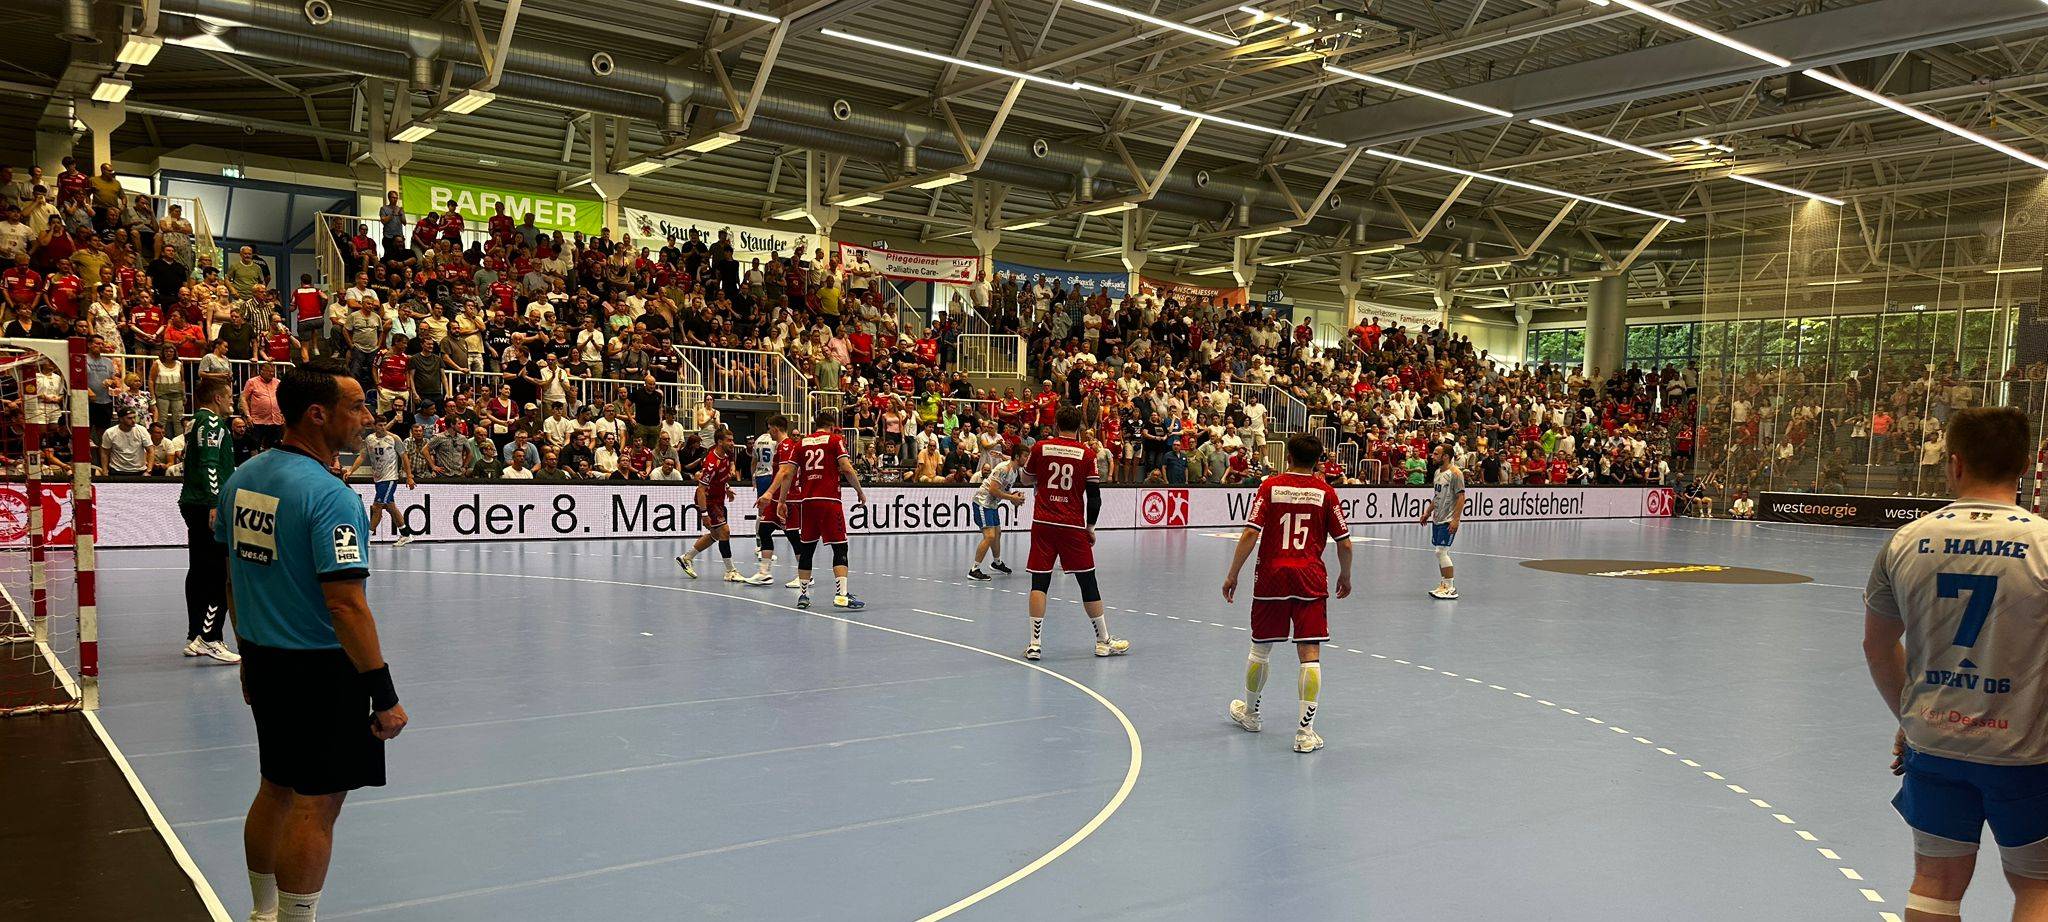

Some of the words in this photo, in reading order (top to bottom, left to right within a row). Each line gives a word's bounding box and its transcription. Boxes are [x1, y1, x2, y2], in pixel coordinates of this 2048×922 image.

[430, 186, 577, 227] BARMER
[660, 220, 710, 243] Stauer
[740, 231, 787, 252] Stauder
[886, 253, 939, 266] Pflegedienst
[374, 447, 384, 456] 18
[756, 448, 771, 463] 15
[805, 448, 824, 470] 22
[1047, 461, 1074, 491] 28
[453, 494, 535, 535] der
[551, 494, 591, 534] 8.
[849, 494, 1019, 529] aufstehn!
[1366, 493, 1383, 518] 8.
[1391, 493, 1433, 518] Man
[1463, 493, 1494, 517] alle
[1499, 491, 1584, 516] aufstehen!
[1773, 502, 1857, 519] westenergie
[235, 506, 275, 536] KÜS
[1332, 504, 1348, 531] Stauder
[1280, 513, 1311, 550] 15
[338, 552, 359, 561] HBL
[1918, 539, 1934, 554] C.
[1944, 539, 2030, 559] HAAKE
[1937, 573, 1998, 648] 7
[1983, 678, 2011, 694] 06
[1948, 709, 2009, 730] Dessau
